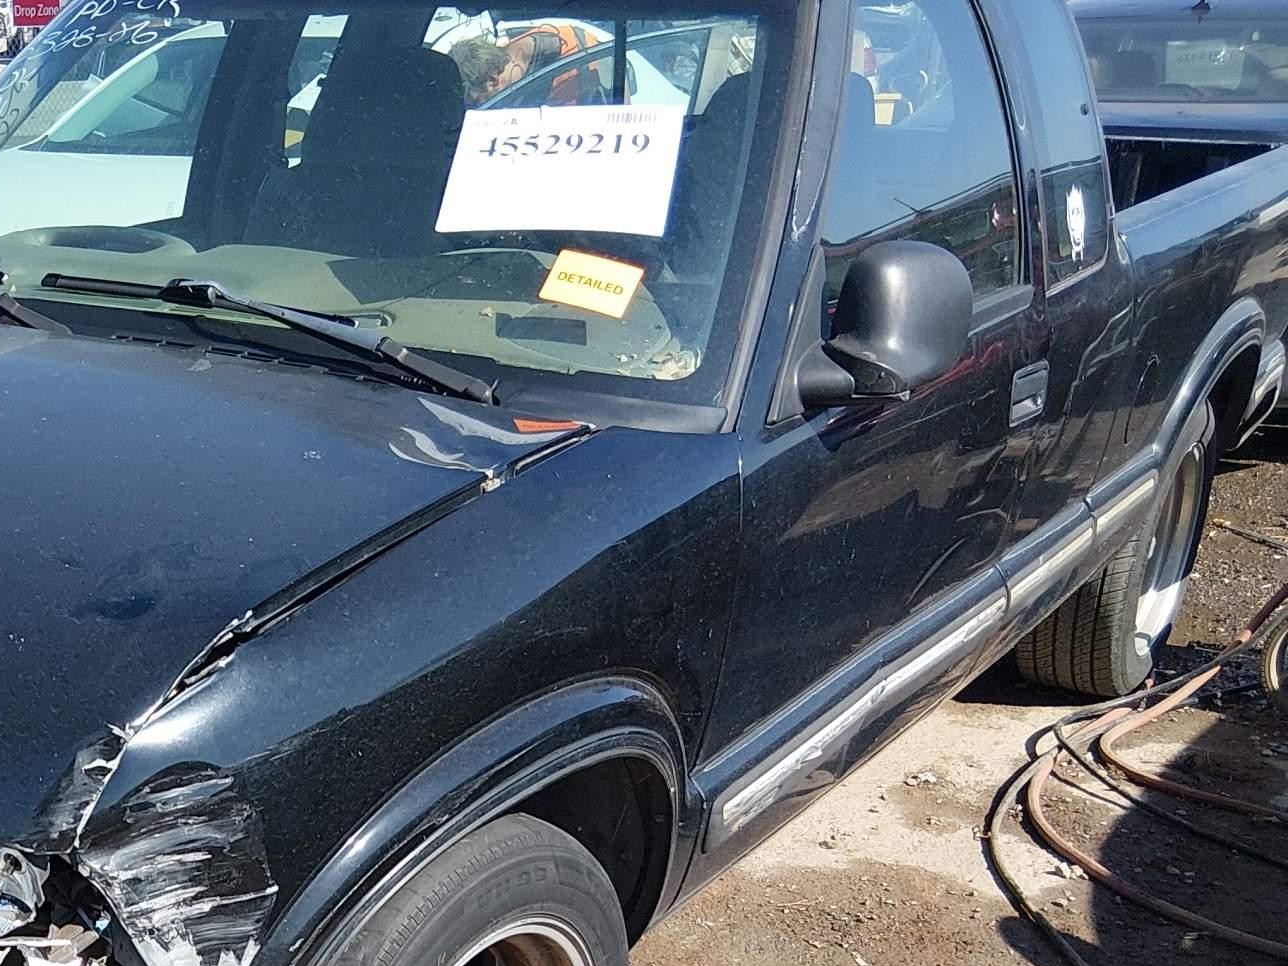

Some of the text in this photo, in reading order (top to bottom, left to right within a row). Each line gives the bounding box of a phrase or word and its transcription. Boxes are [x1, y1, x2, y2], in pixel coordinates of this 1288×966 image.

[14, 4, 59, 18] Drop Zone
[479, 133, 650, 157] 45529219
[557, 271, 624, 296] DETAILED
